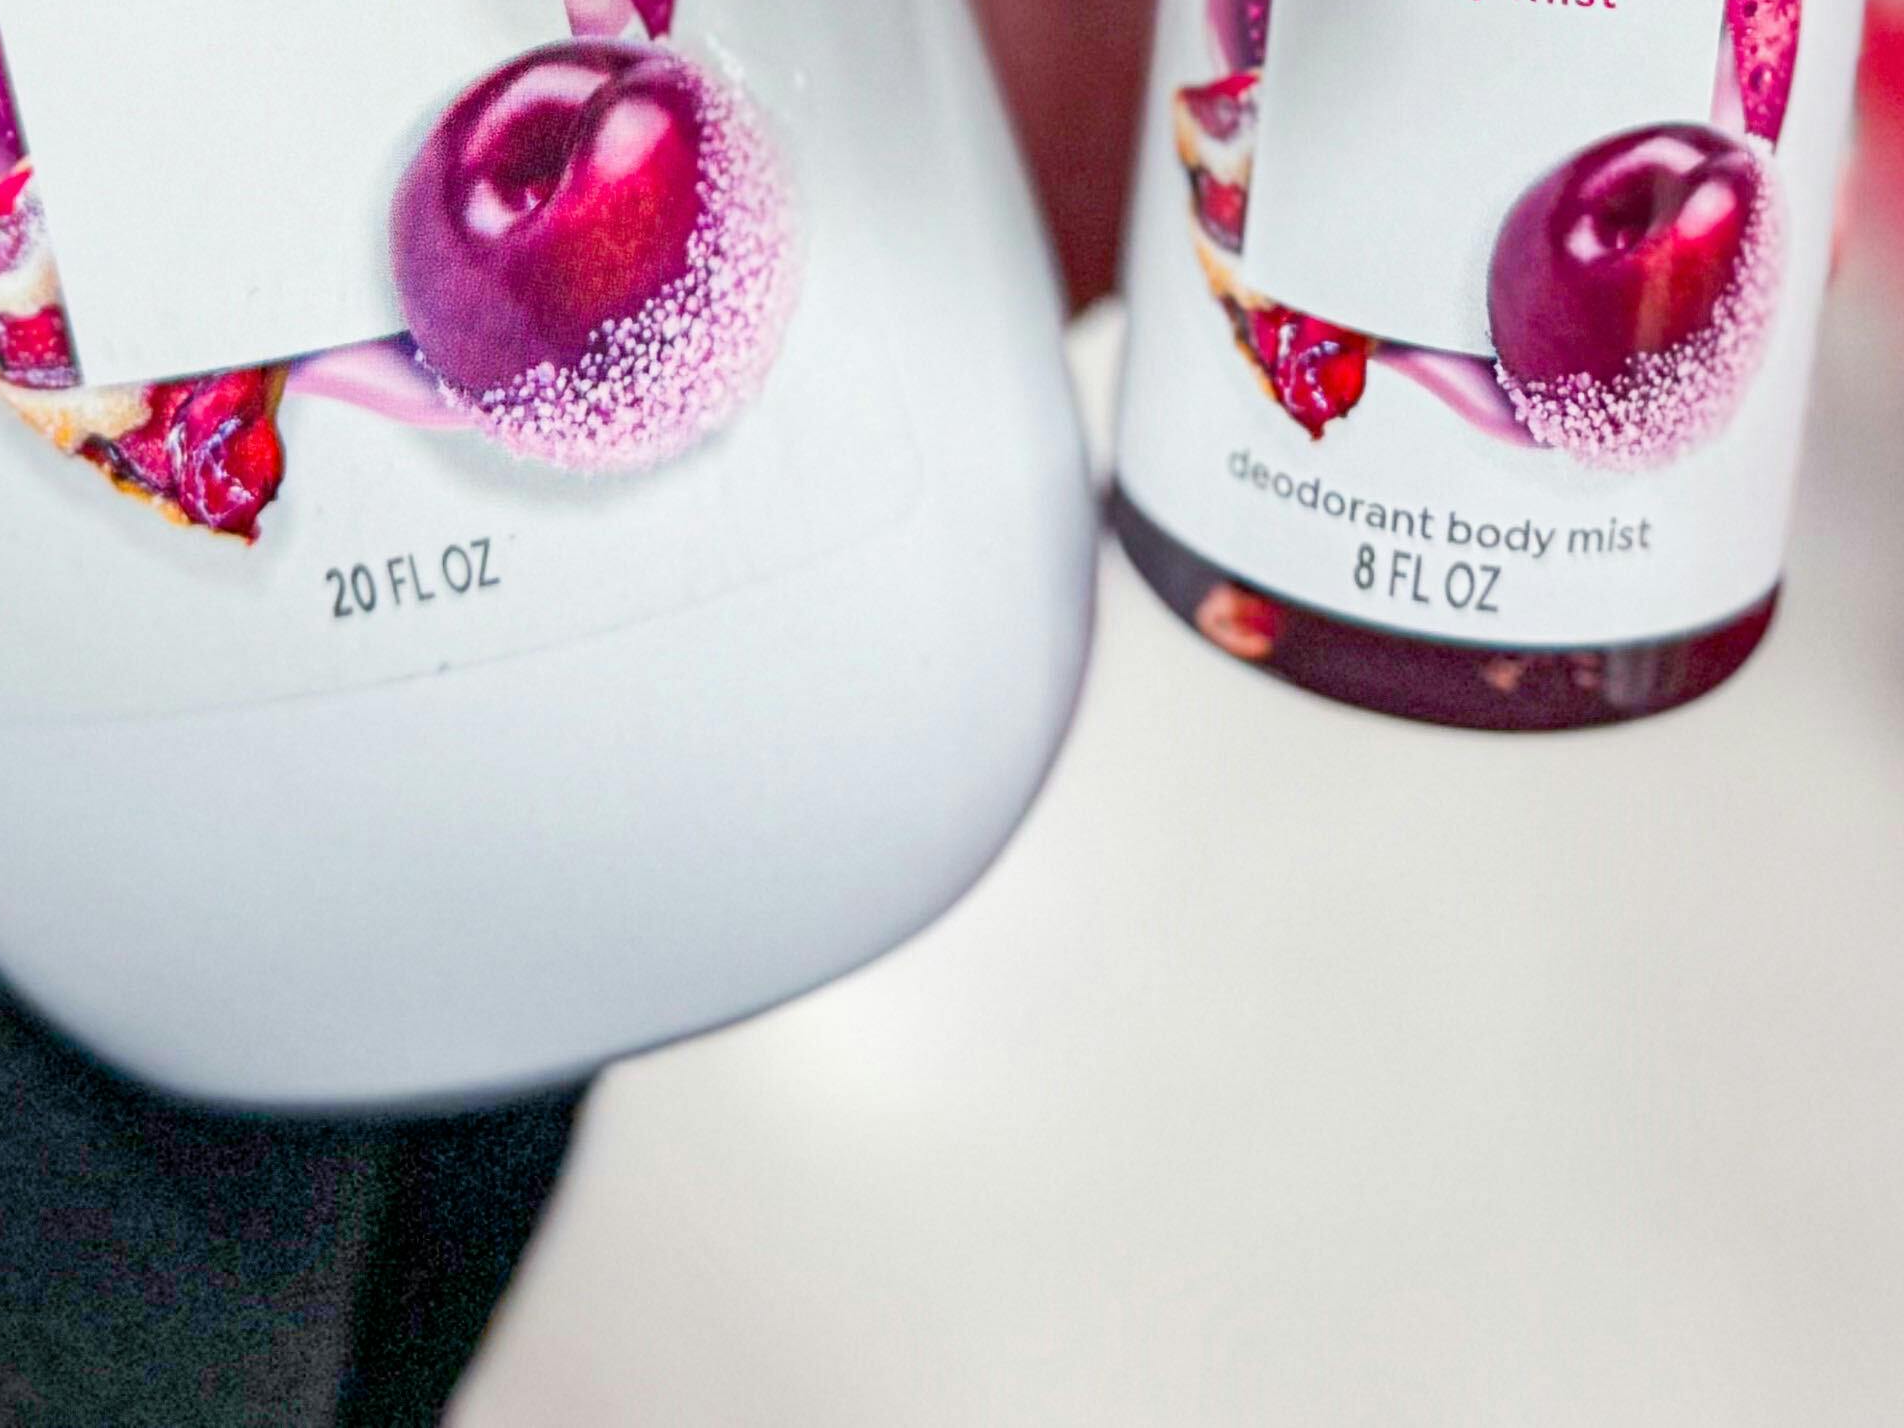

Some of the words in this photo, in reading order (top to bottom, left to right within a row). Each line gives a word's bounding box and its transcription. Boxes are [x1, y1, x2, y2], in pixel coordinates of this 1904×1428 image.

[1227, 447, 1435, 541] deodorant
[1446, 512, 1556, 559] body
[1566, 517, 1653, 555] mist
[325, 562, 377, 619] 20
[386, 554, 436, 606] FL
[441, 537, 501, 595] OZ
[1353, 542, 1376, 591] 8
[1388, 549, 1431, 605] FL
[1444, 560, 1502, 613] OZ
